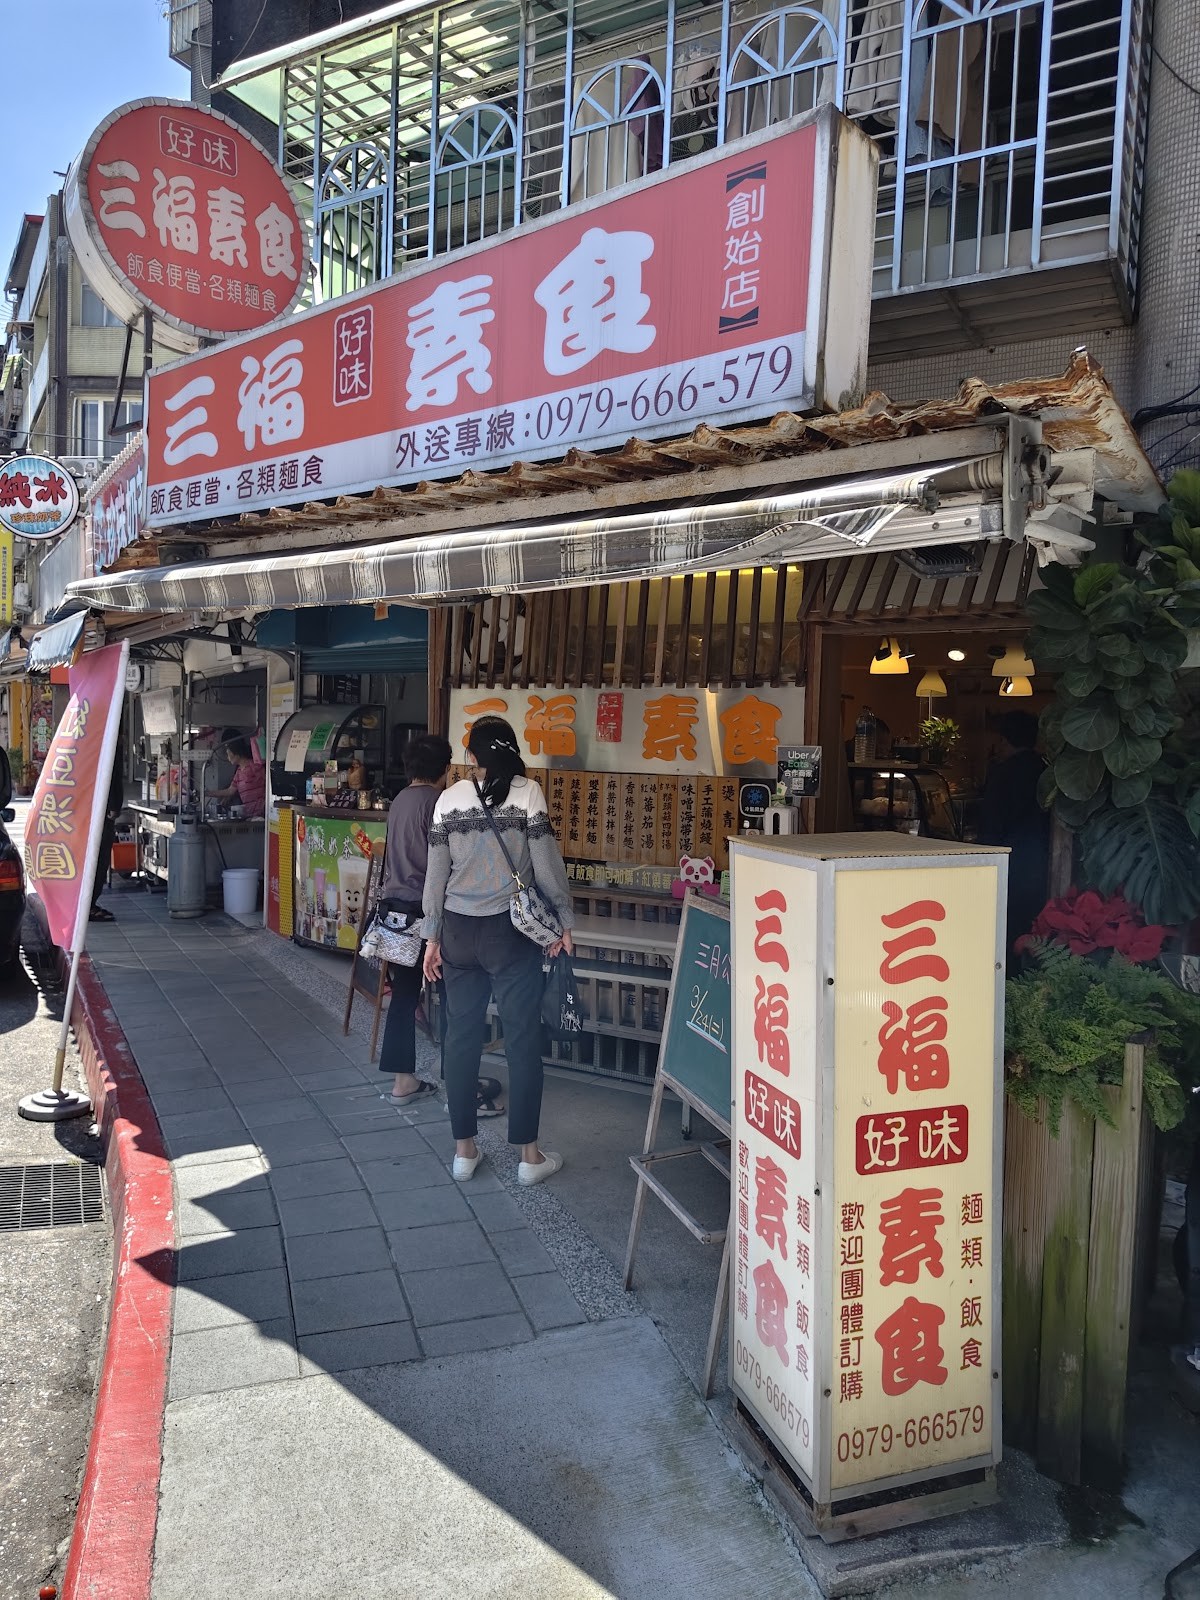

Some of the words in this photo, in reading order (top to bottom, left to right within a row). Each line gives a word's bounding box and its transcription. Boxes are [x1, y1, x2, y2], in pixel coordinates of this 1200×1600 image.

[166, 127, 233, 170] 好味
[97, 160, 298, 282] 三福素食
[164, 338, 305, 467] 三福
[340, 314, 368, 402] 好味
[405, 226, 657, 412] 素食
[0, 471, 67, 509] 純冰
[642, 694, 783, 766] 素食
[787, 750, 810, 759] Uber
[787, 760, 810, 768] Eats
[784, 769, 813, 778] 合作商家
[679, 783, 696, 852] 味噌海帶湯
[754, 889, 791, 1078] 三福
[877, 900, 950, 1095] 三福
[747, 1076, 798, 1151] 好味
[863, 1109, 962, 1171] 好味
[752, 1155, 790, 1368] 素食
[874, 1187, 949, 1397] 素食
[839, 1202, 865, 1403] 歡迎團體訂購
[736, 1339, 810, 1449] 0979-666579
[837, 1404, 985, 1463] 0979-666579
